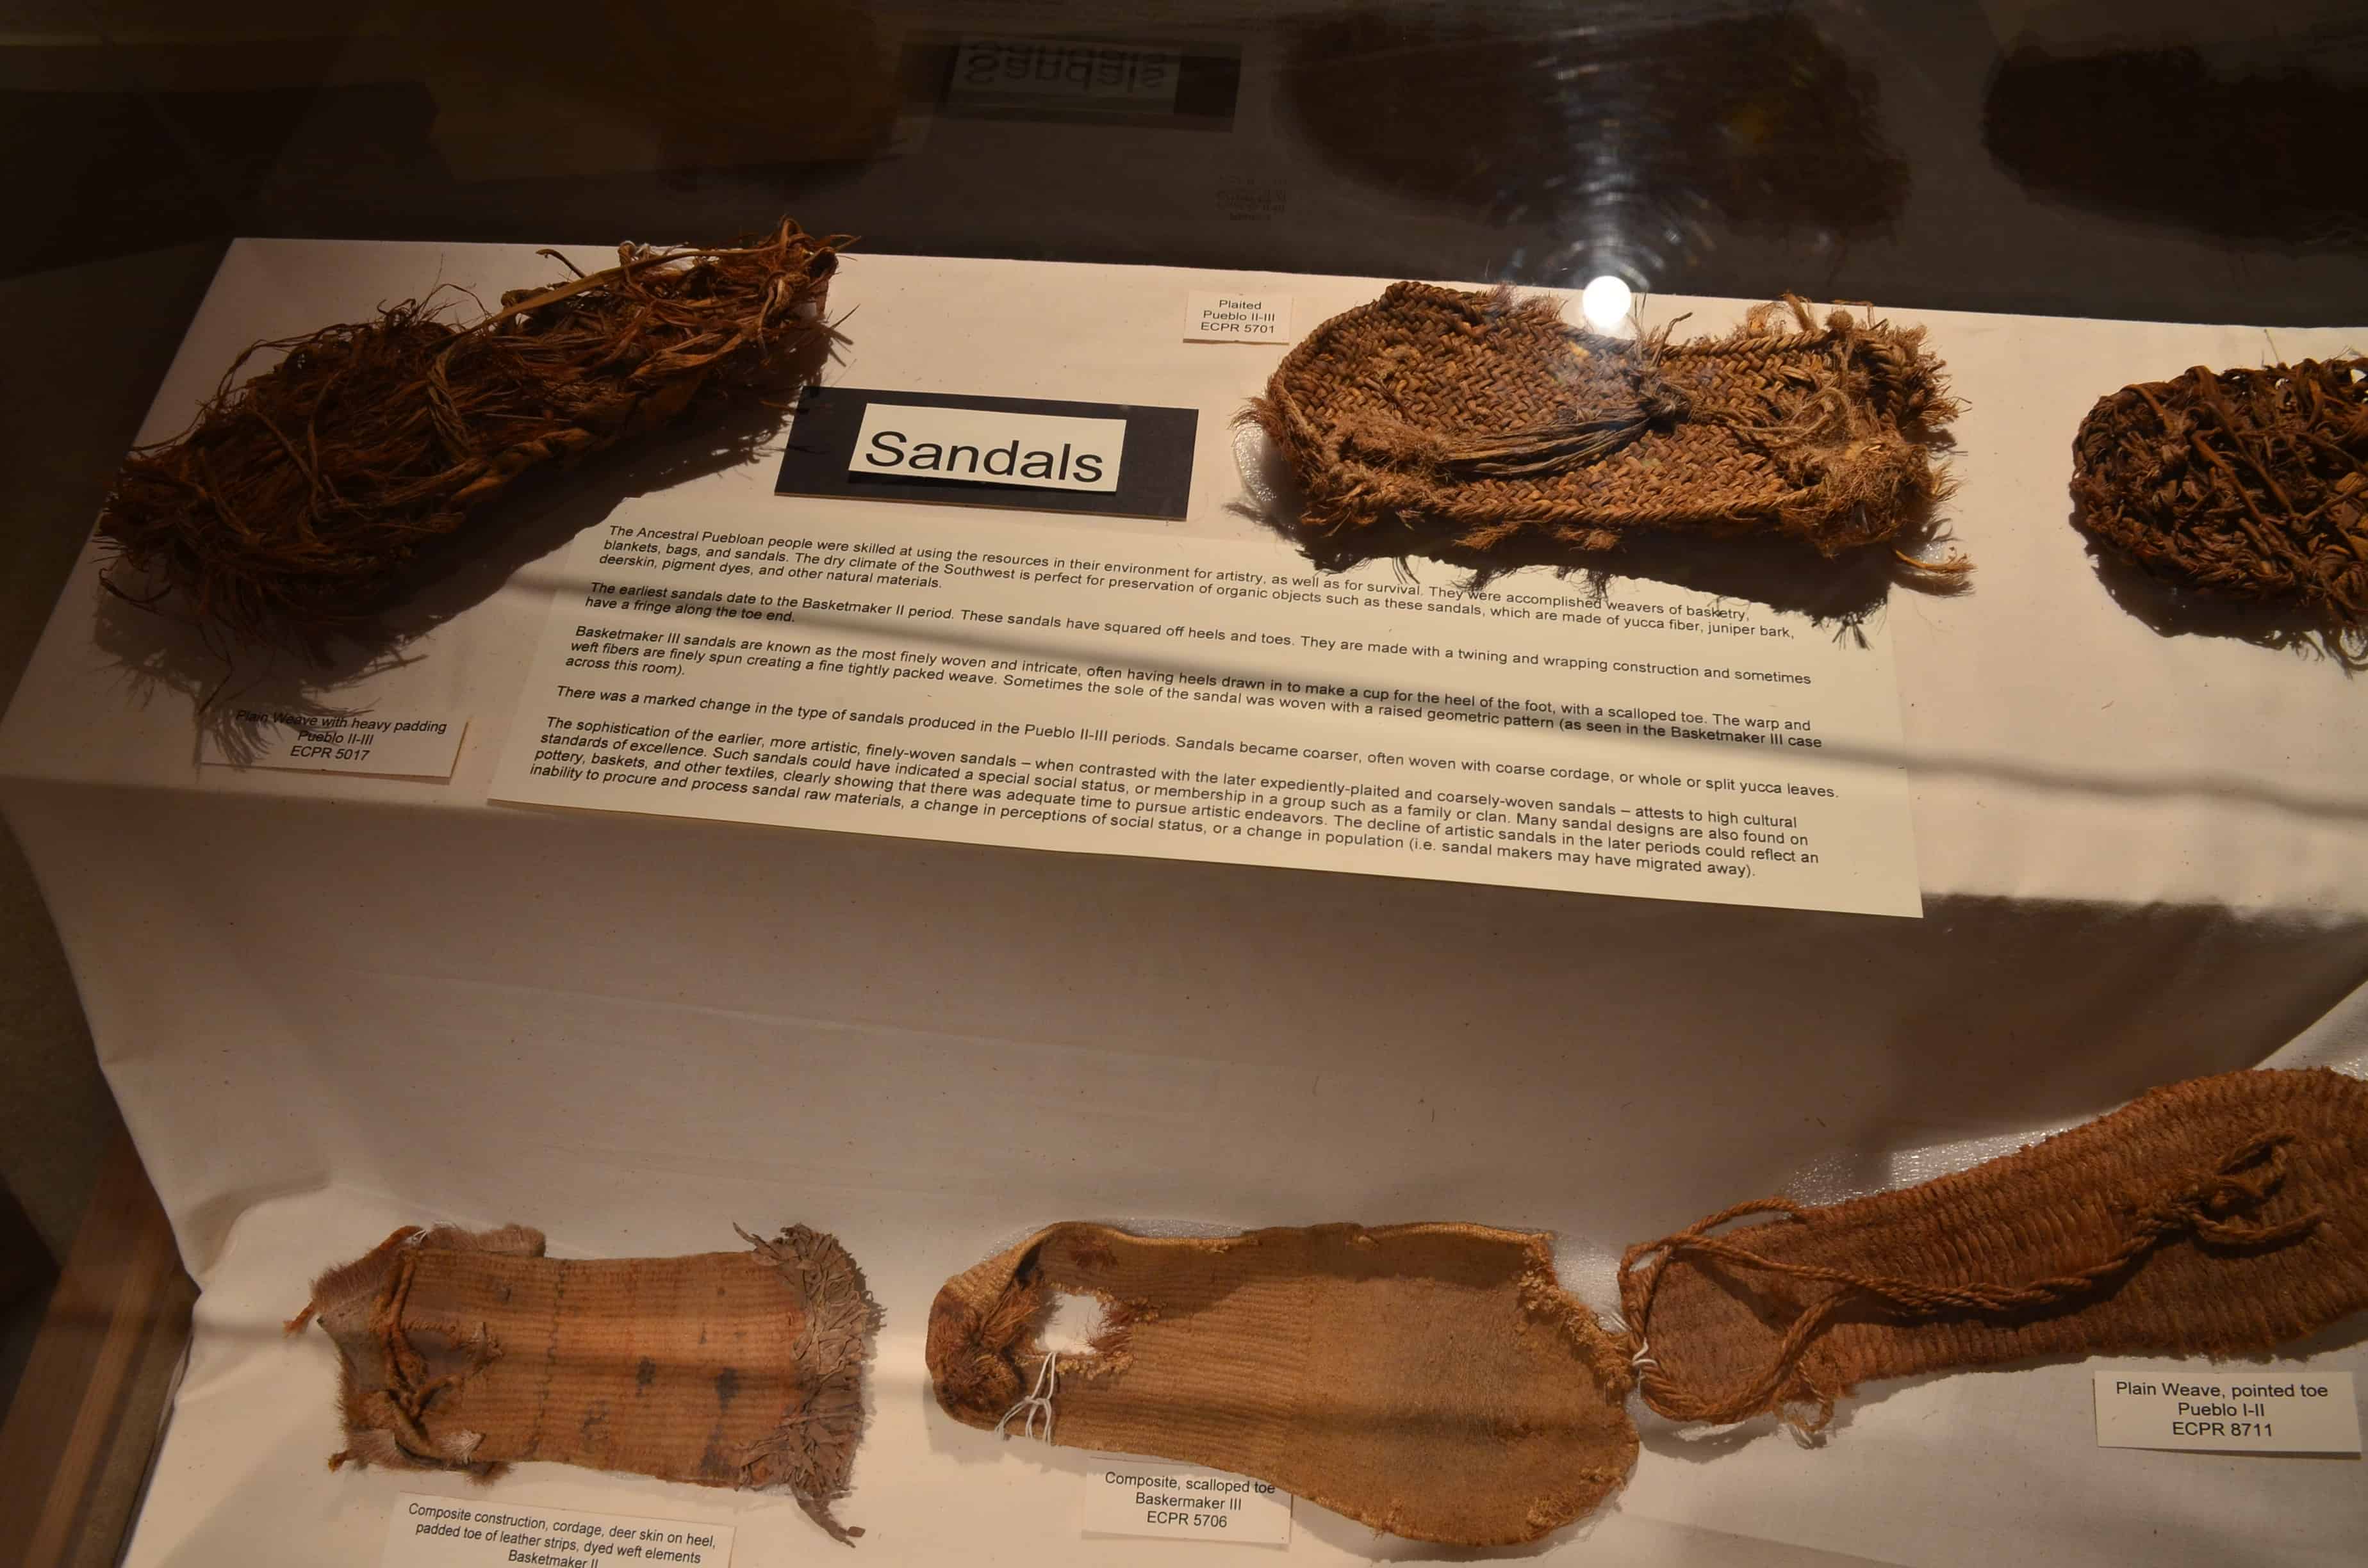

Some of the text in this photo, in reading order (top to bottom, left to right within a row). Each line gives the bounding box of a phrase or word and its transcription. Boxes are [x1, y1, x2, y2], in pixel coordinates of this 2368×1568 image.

[1219, 300, 1262, 310] Plaited
[1203, 310, 1275, 322] Pueblo II-III
[1201, 322, 1274, 334] ECPR 5701
[865, 430, 1103, 483] Sandals
[599, 553, 941, 588] deerskin, pigment dyes, and other natural materials.
[609, 525, 1749, 621] The Ancestral Puebloan people were skilled at using the resources in their environment for artistry, as well as for survival. They were accomplished weavers of basketry,
[584, 596, 794, 622] have a fringe along the toe end.
[589, 582, 1811, 684] The earliest sandals date to the Basketmaker II period. These sandals have squared off heels and toes. They are made with a twining and wrapping construction and sometimes
[565, 657, 685, 677] across this room).
[236, 710, 447, 735] Plain Weave with heavy padding
[297, 730, 374, 745] Pueblo II-III
[557, 685, 1839, 798] There was a marked change in the type of sandals produced in the Pueblo II-III periods. Sandals became coarser, often woven with coarse cordage, or whole or split yucca leaves.
[290, 746, 370, 760] ECPR 5017
[2116, 1382, 2328, 1400] Plain Weave, pointed toe
[2178, 1402, 2264, 1416] Pueblo I-II
[2172, 1421, 2272, 1437] ECPR 8711
[1105, 1471, 1276, 1494] Composite, scalloped toe
[1136, 1492, 1242, 1510] Baskermaker III
[409, 1503, 716, 1549] Composite construction, cordage, deer skin on heel,
[1147, 1510, 1227, 1528] ECPR 5706
[415, 1523, 702, 1564] padded toe of leather strips, dyed weft elements
[508, 1549, 588, 1568] Basketmaker
